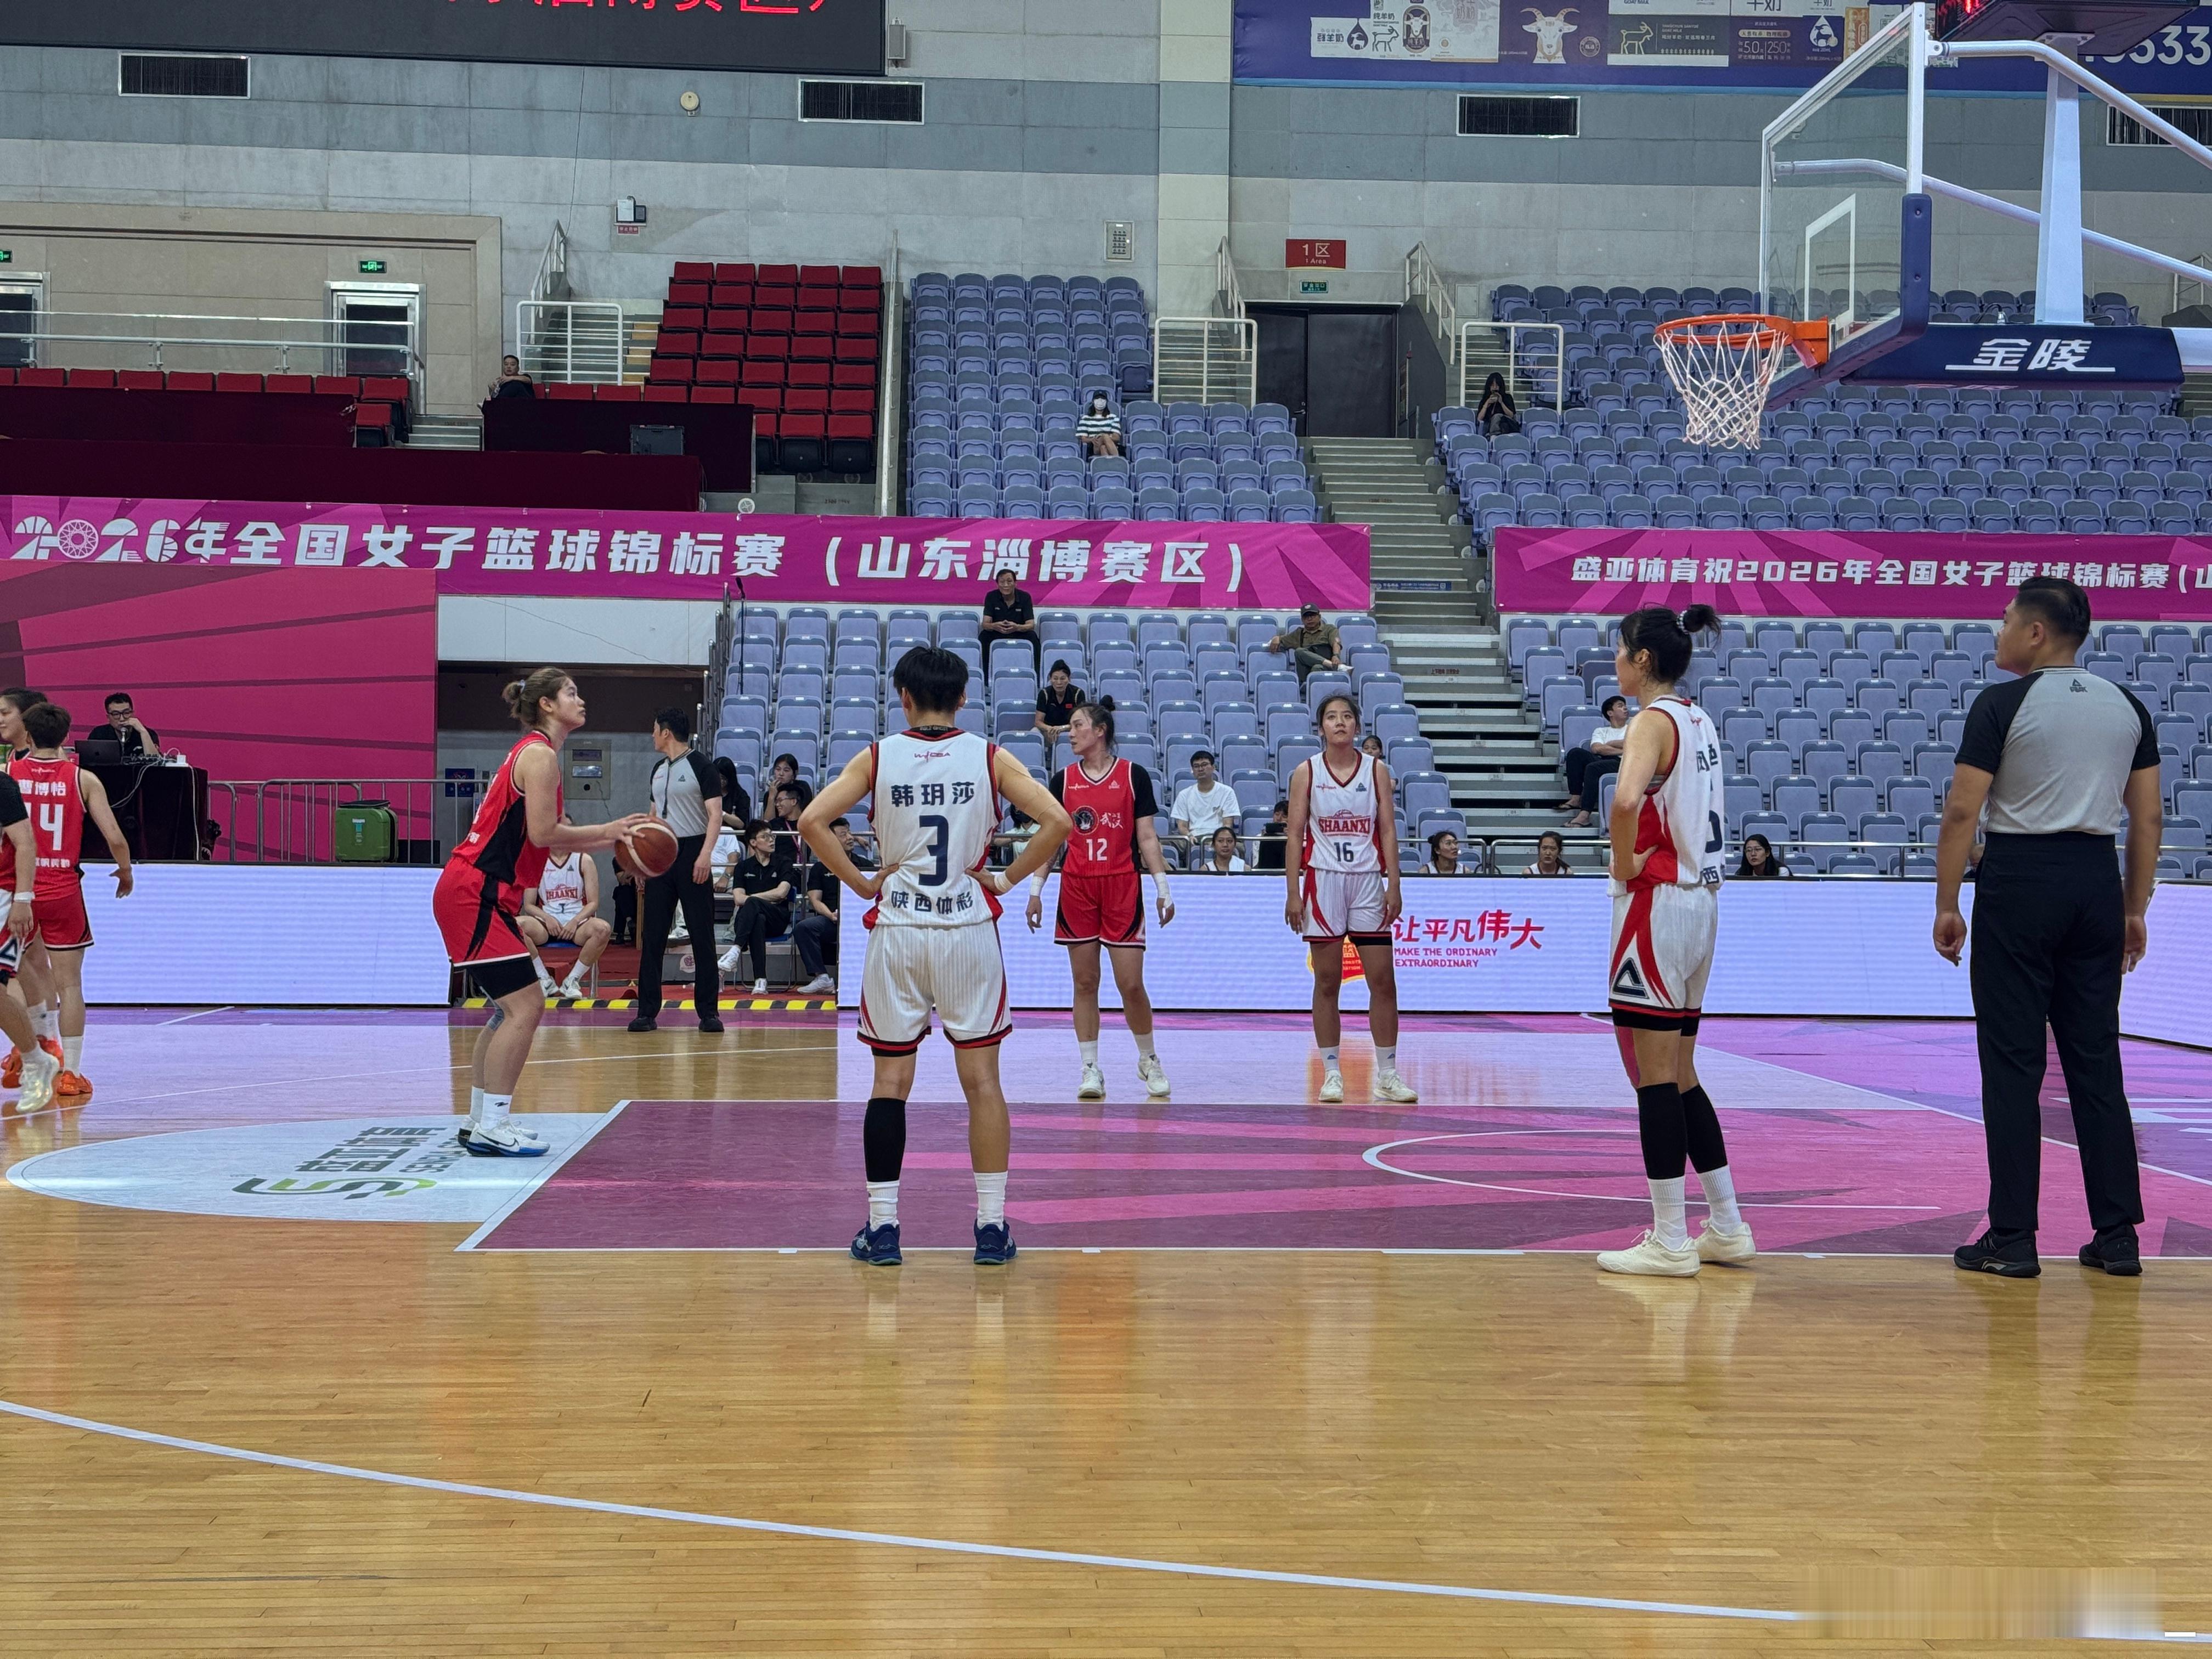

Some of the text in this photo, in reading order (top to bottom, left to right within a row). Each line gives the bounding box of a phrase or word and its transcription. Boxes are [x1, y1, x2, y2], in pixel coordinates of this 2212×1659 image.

[1302, 243, 1330, 257] 1 区
[1945, 338, 2116, 373] 金陵
[891, 781, 975, 808] 韩玥莎
[1318, 817, 1371, 835] SHAANXI
[918, 815, 949, 887] 3
[1086, 838, 1107, 861] 12
[1334, 842, 1354, 862] 16
[891, 890, 973, 915] 陕西体彩
[1393, 909, 1545, 950] 让平凡伟大
[1395, 948, 1498, 957] MAKE THE ORDINARY
[1395, 959, 1479, 968] EXTRAORDINARY
